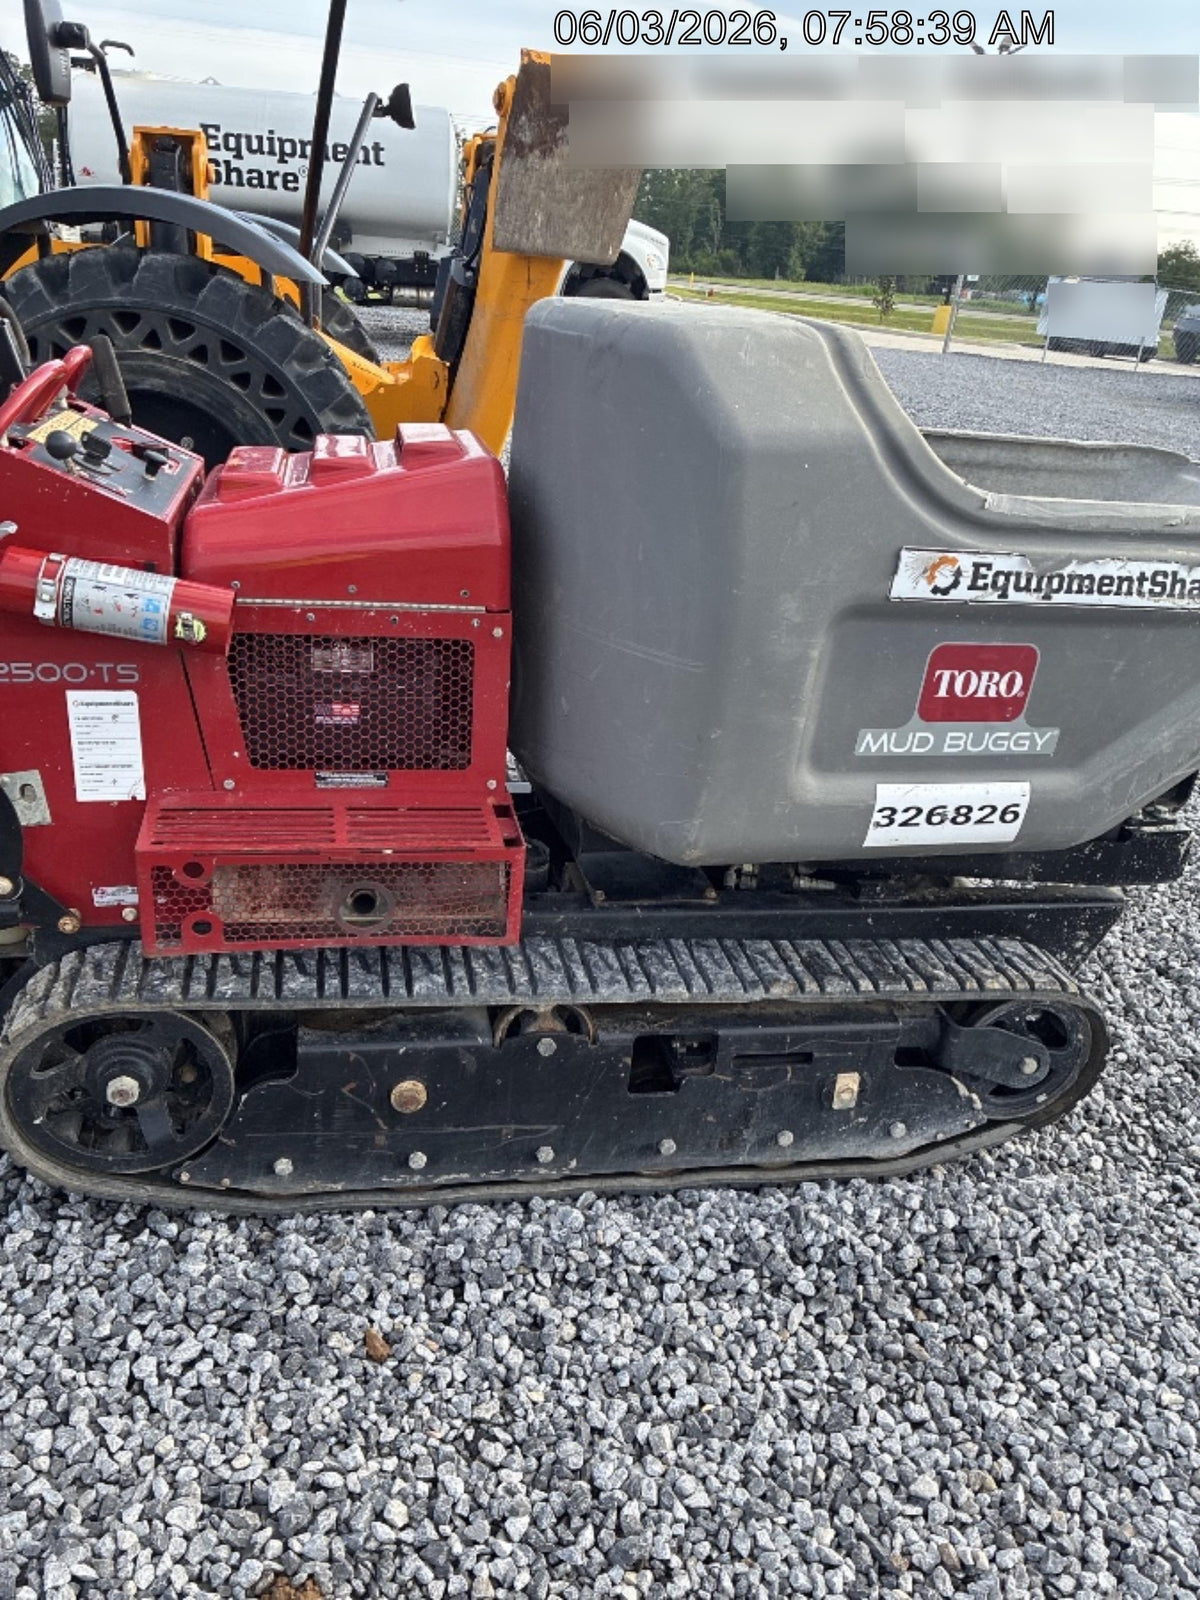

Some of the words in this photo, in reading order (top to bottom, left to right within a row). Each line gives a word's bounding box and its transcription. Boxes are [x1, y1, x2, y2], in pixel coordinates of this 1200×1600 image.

[200, 123, 386, 167] Equipment
[933, 669, 1023, 698] TORO
[858, 731, 935, 753] MUD
[942, 731, 1053, 752] BUGGY
[874, 803, 1021, 828] 326826
